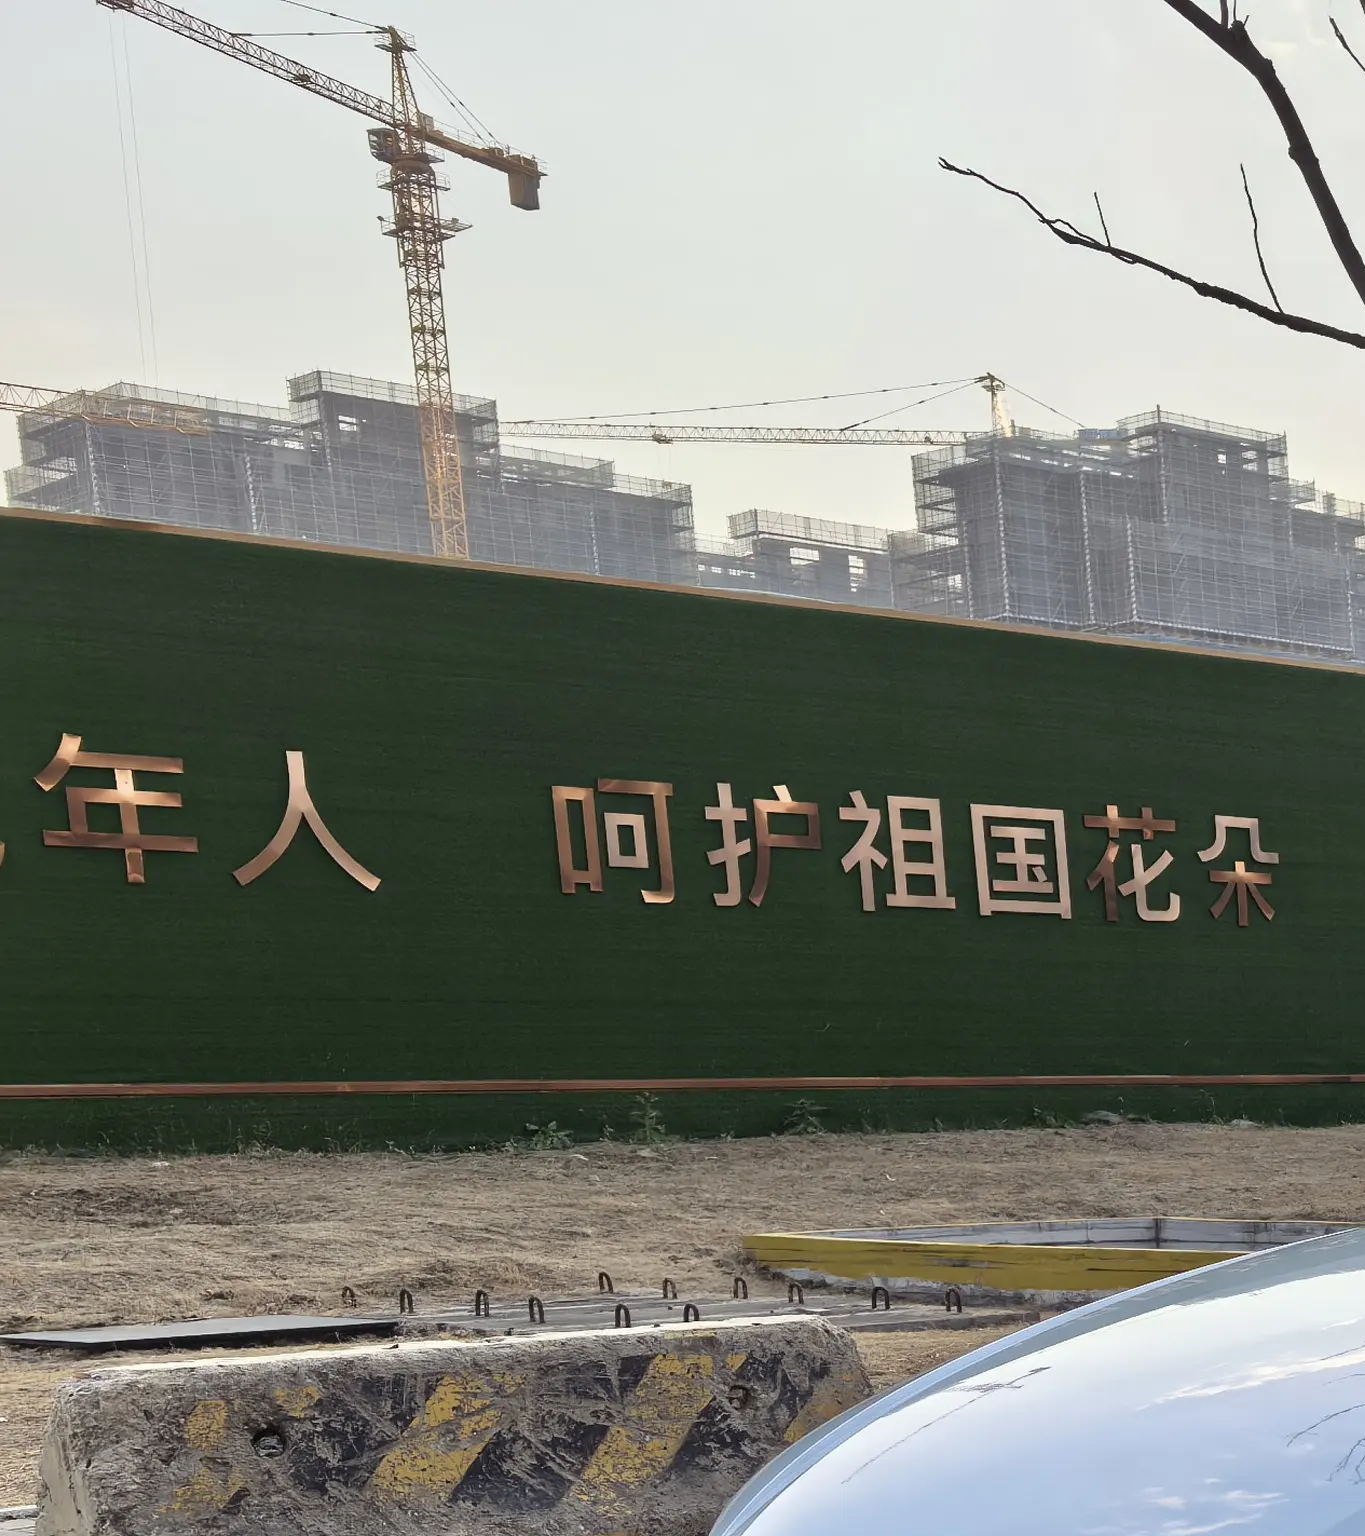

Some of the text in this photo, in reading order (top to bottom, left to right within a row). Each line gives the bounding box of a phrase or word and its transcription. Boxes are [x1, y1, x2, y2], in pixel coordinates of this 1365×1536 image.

[0, 733, 1281, 928] 年人 呵护祖国花朵
